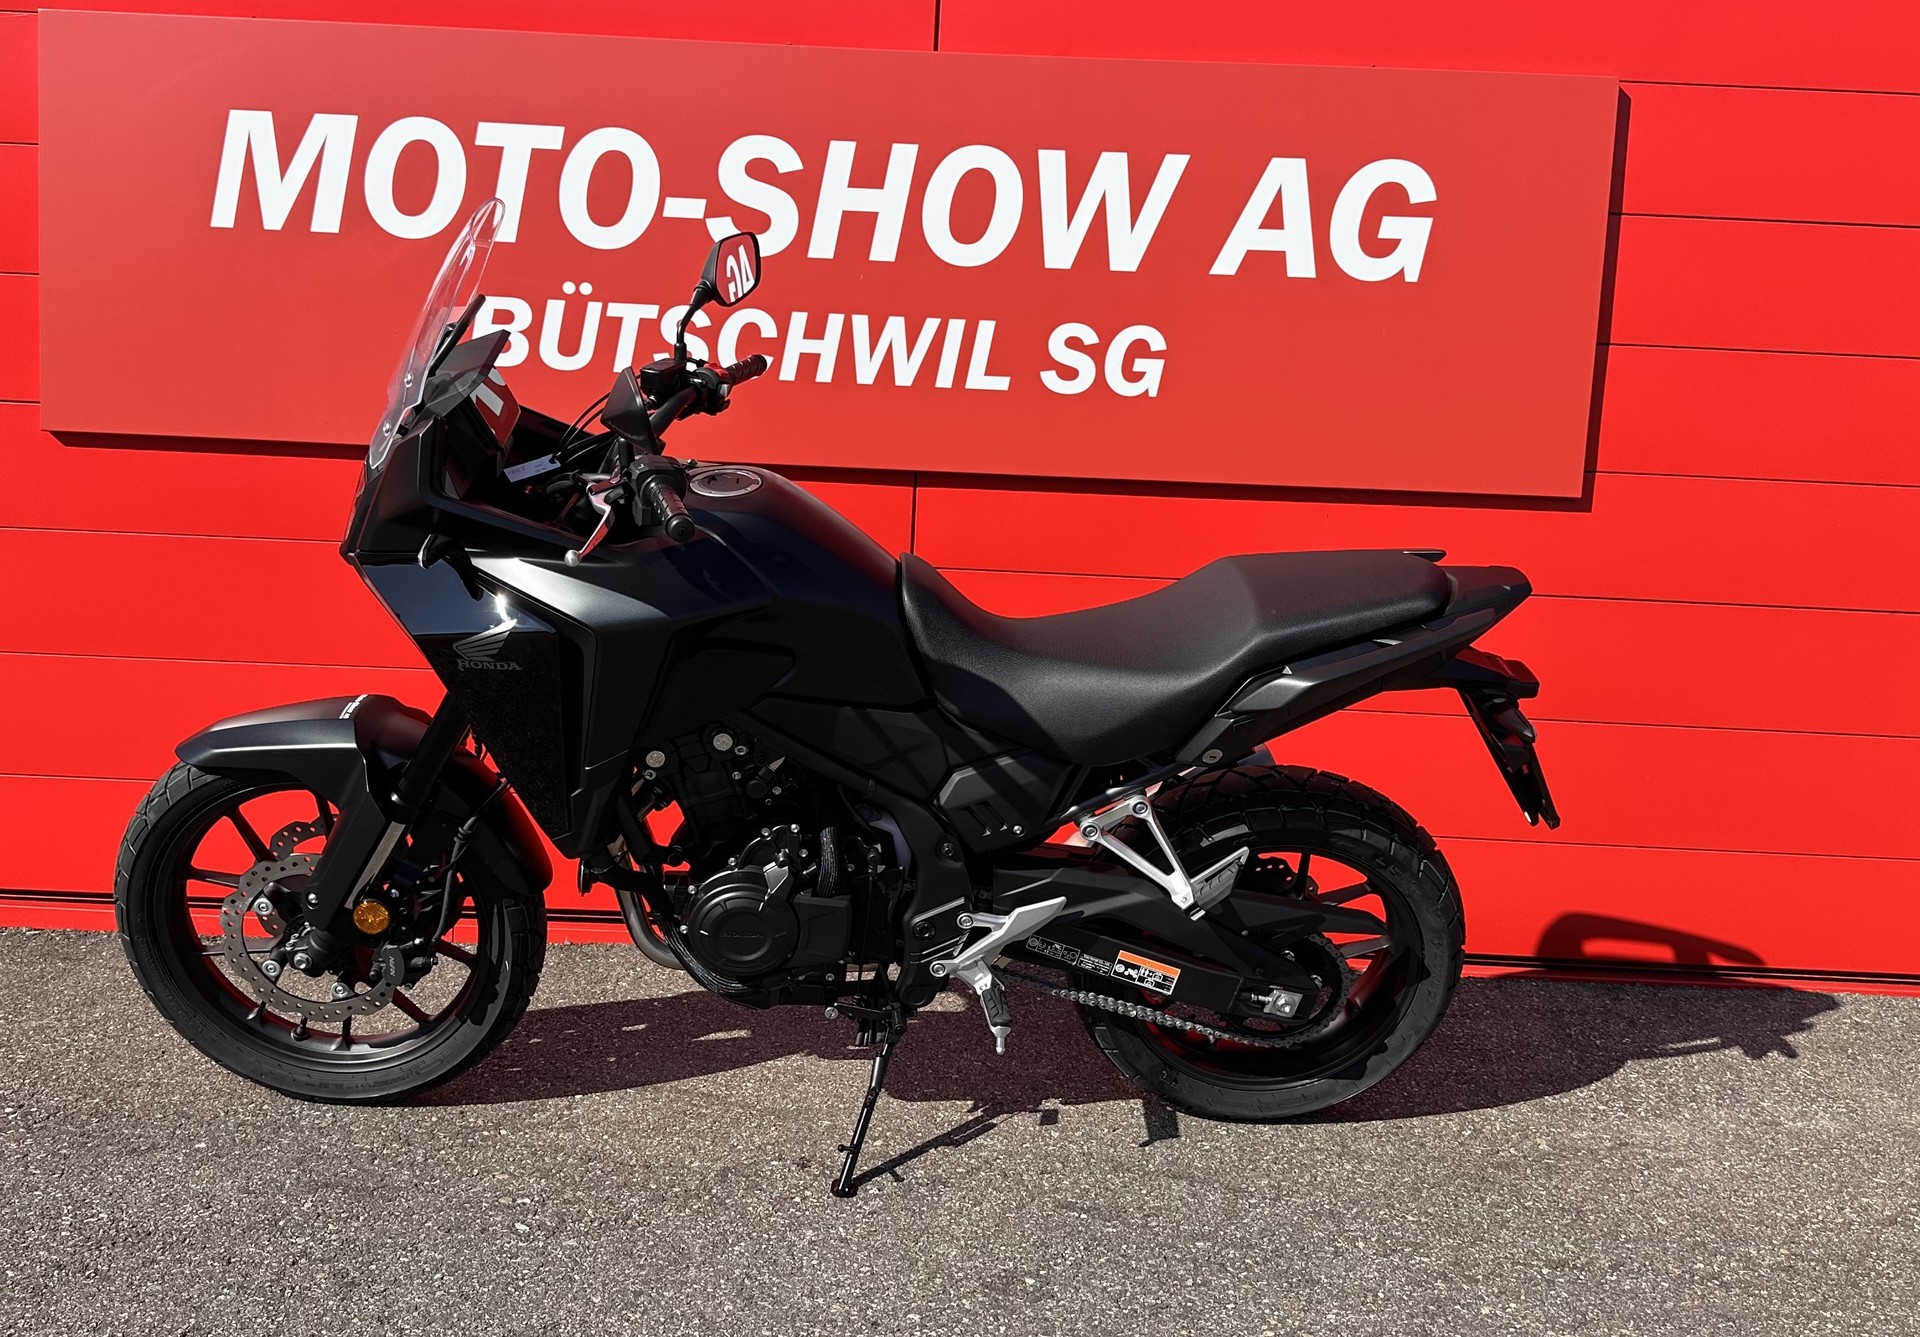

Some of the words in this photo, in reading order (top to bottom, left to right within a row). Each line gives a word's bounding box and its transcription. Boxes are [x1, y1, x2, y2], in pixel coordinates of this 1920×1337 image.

[211, 109, 1190, 272] MOTO-SHOW
[1209, 157, 1437, 283] AG
[470, 282, 1011, 391] BÜTSCHWIL
[1040, 322, 1167, 398] SG
[456, 658, 523, 671] HONDA
